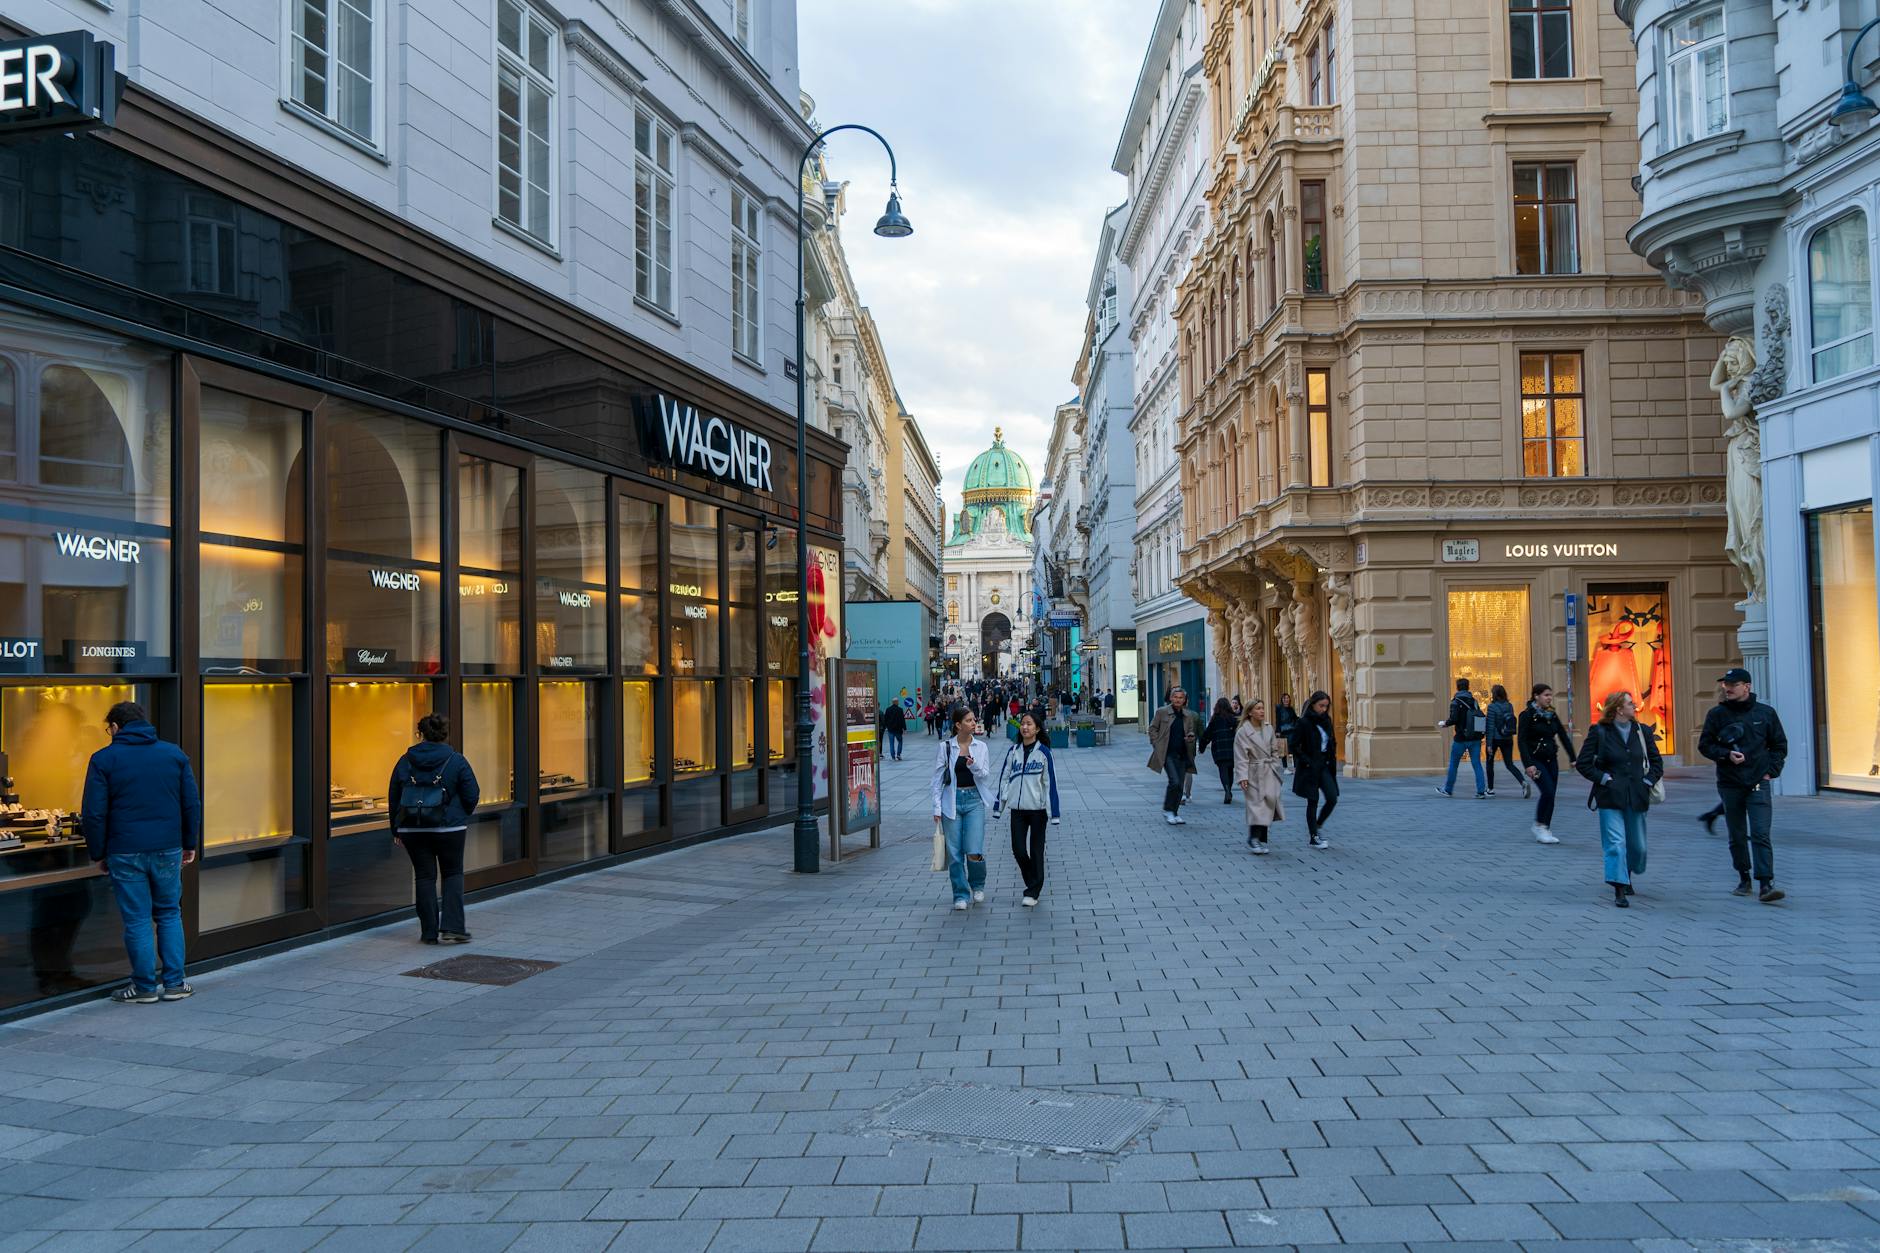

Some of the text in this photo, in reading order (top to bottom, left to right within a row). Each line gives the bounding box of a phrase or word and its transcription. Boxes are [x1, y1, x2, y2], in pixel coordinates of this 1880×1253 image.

[659, 394, 773, 492] WAGNER
[56, 532, 140, 564] WAGNER
[1505, 544, 1617, 557] LOUIS VUITTON
[371, 570, 420, 591] WAGNER
[560, 591, 591, 608] WAGNER
[684, 604, 707, 619] WAGNER
[0, 641, 38, 658] LOT
[82, 646, 136, 657] LONGINES
[357, 649, 388, 666] Chopard
[550, 656, 573, 667] WAGNER
